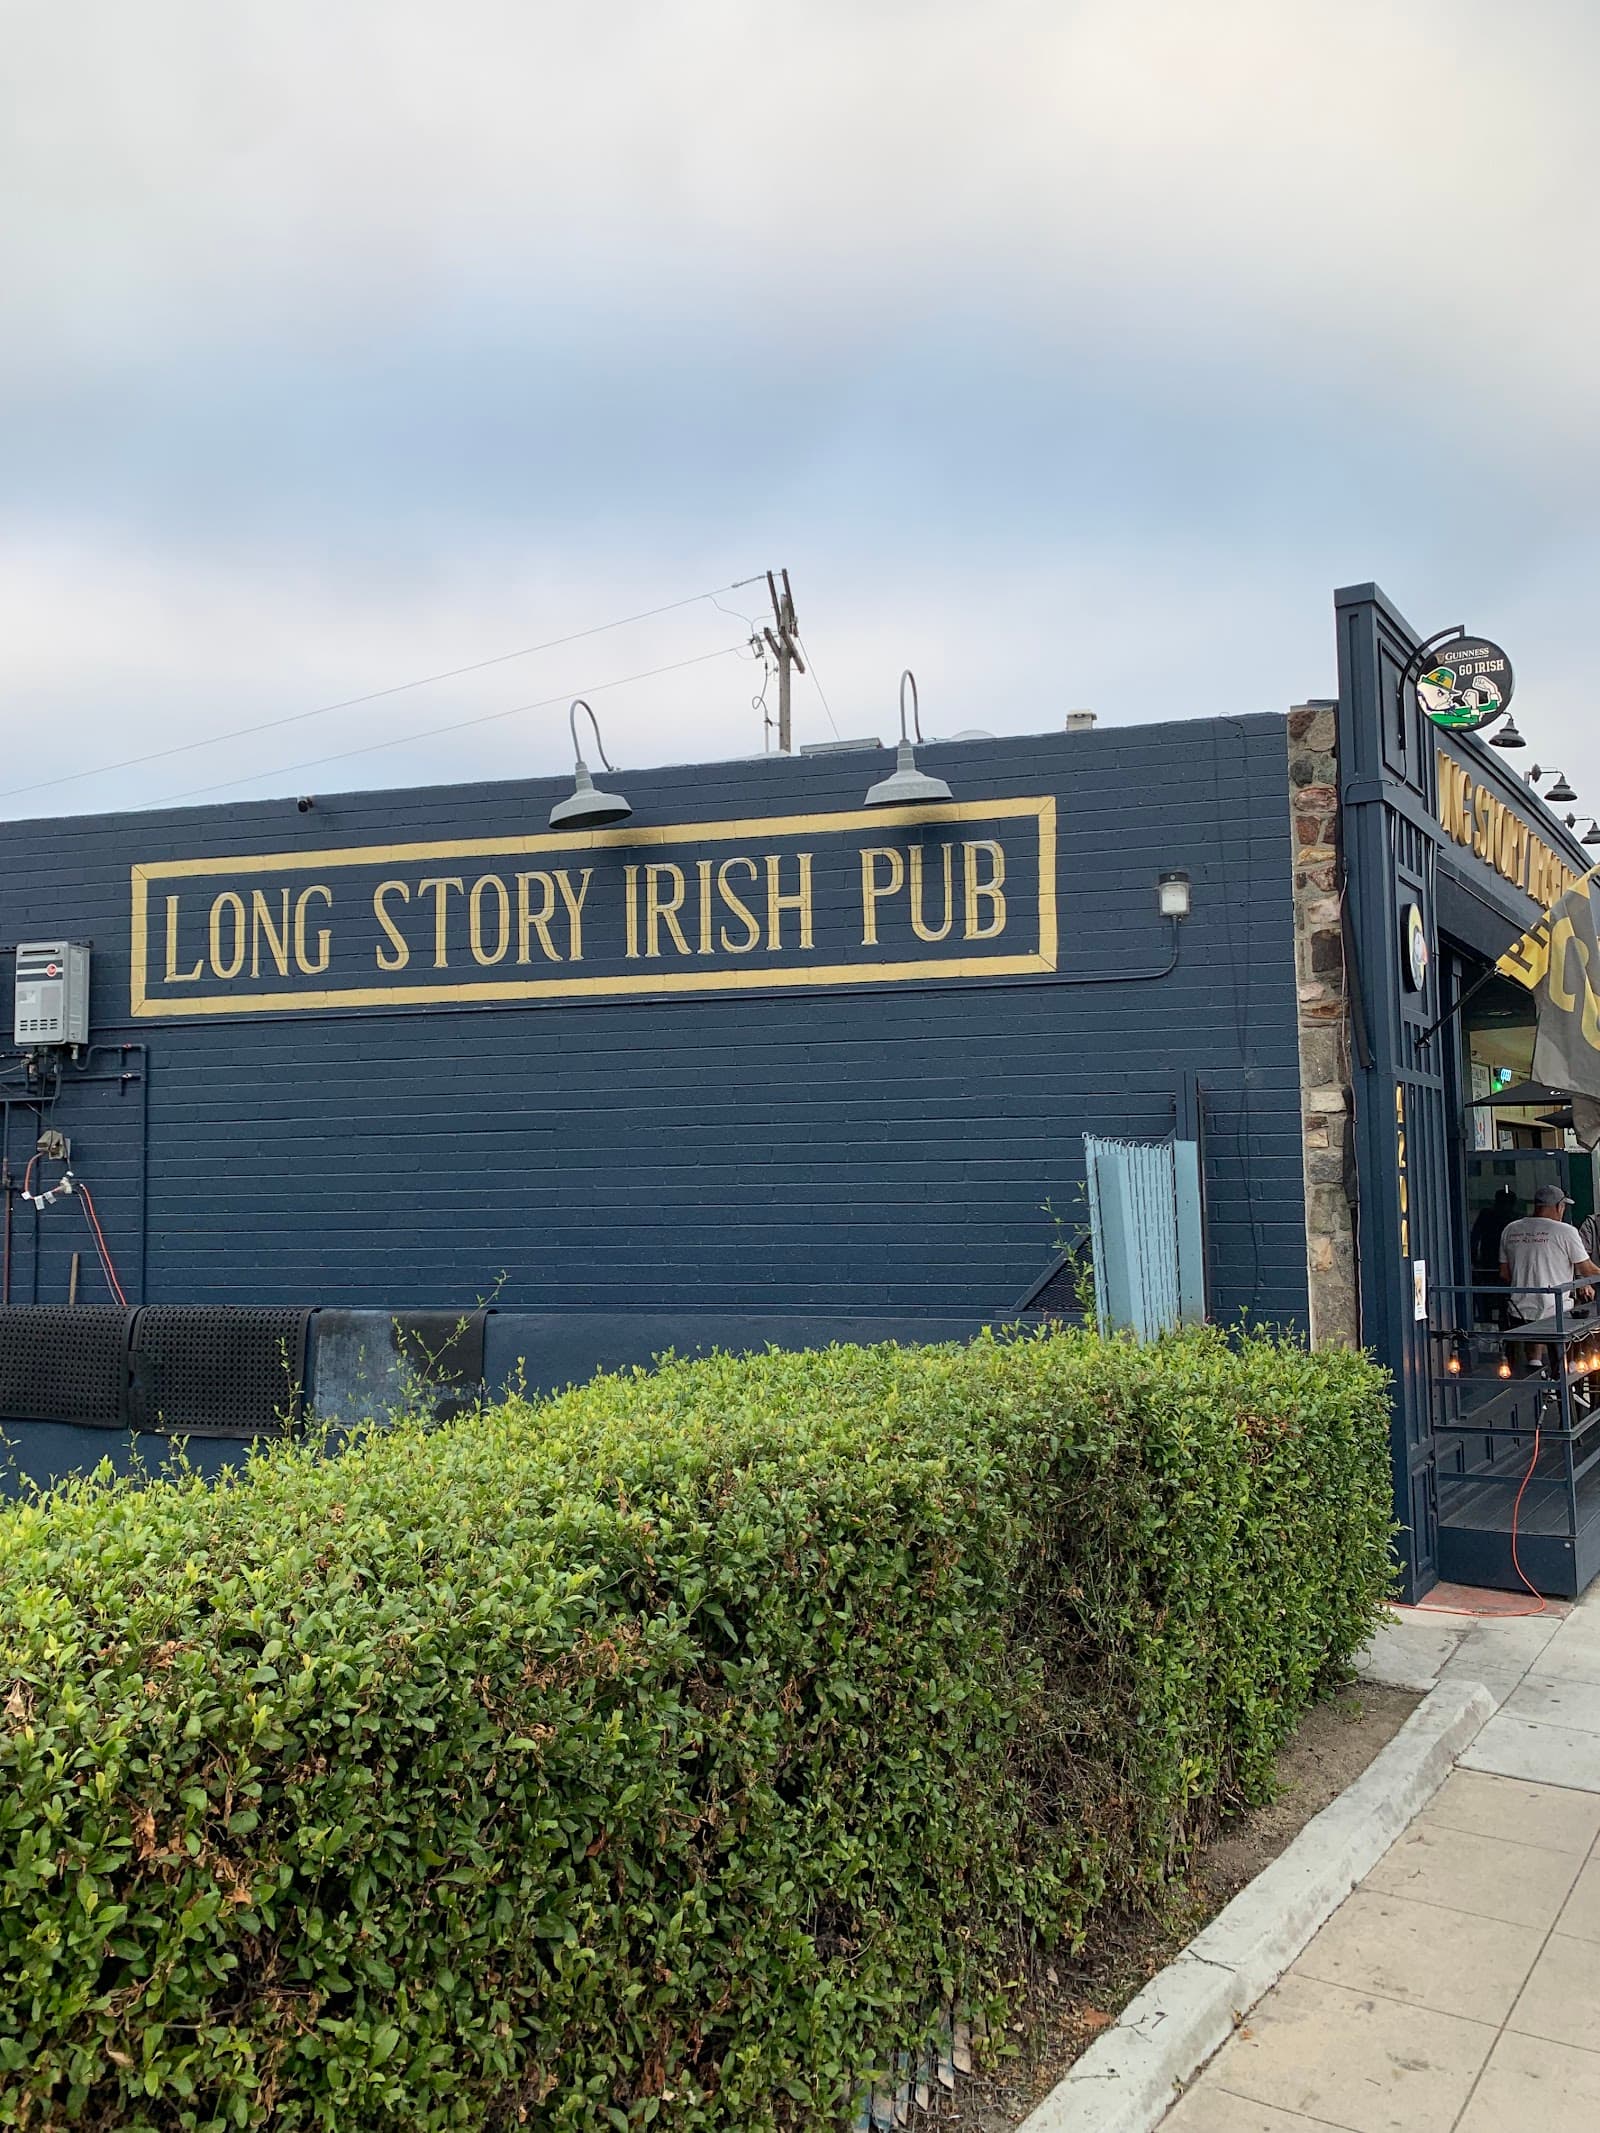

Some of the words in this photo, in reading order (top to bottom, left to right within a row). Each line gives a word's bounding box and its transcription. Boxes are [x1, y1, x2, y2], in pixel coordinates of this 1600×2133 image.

[1445, 648, 1489, 661] GUINNESS
[1459, 664, 1473, 676] GO
[1475, 659, 1504, 674] IRISH
[163, 885, 333, 984] LONG
[373, 868, 594, 971] STORY
[623, 853, 815, 959] IRISH
[859, 840, 1007, 946] PUB
